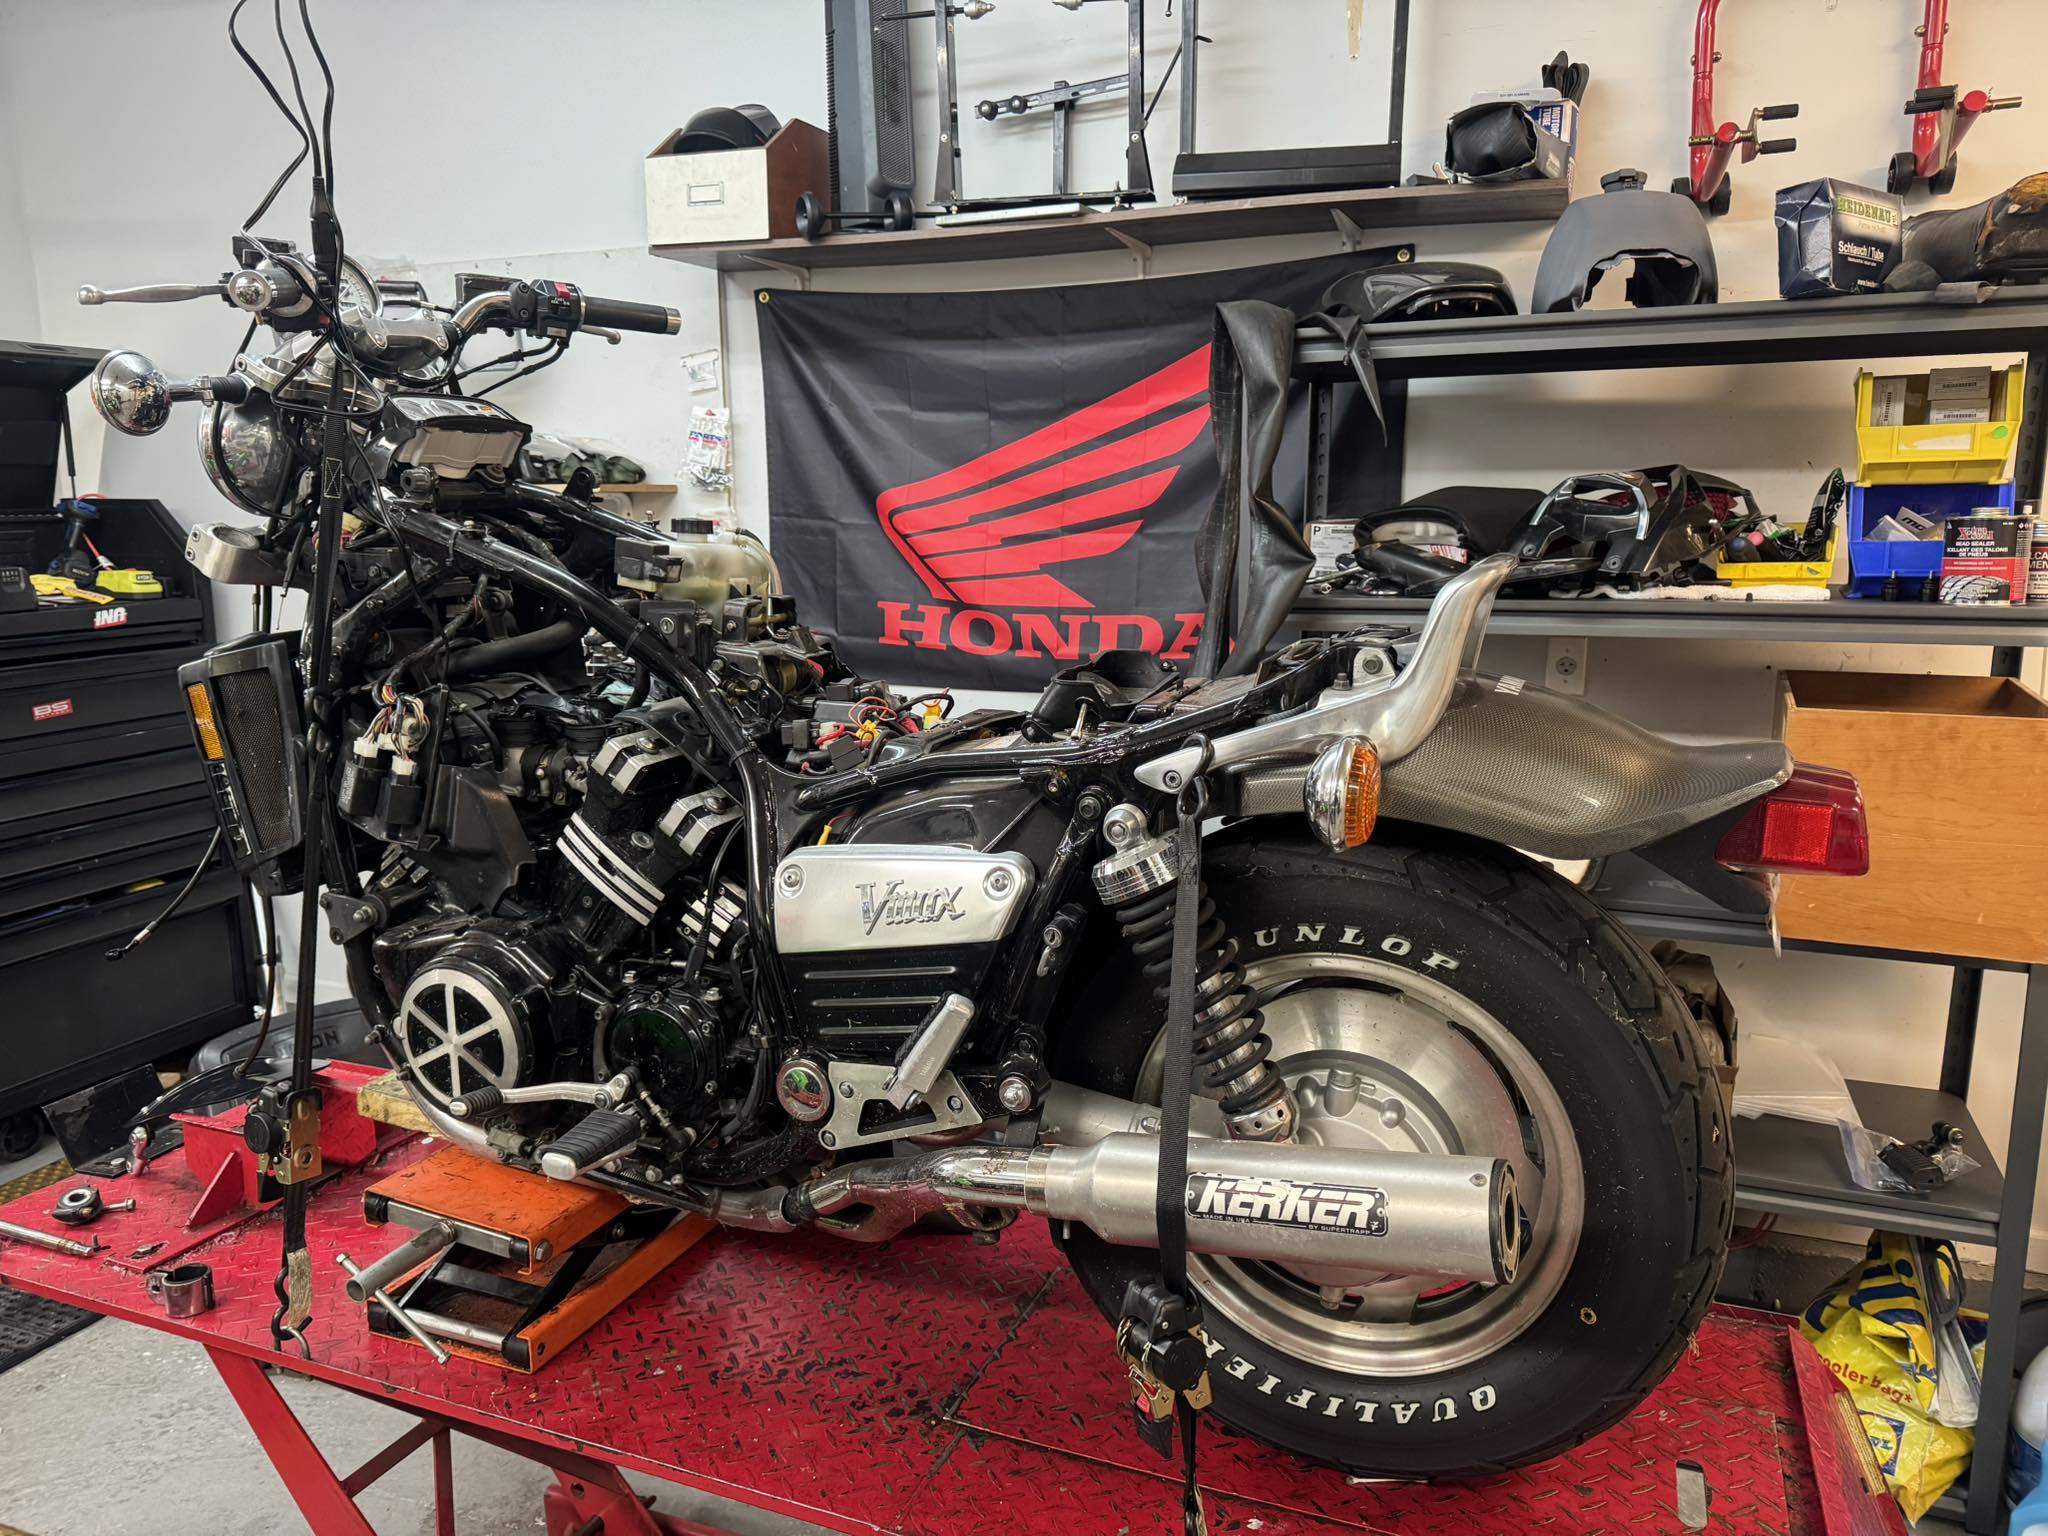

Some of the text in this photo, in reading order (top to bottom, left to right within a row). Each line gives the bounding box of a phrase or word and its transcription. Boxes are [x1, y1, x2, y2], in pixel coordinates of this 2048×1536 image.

[1838, 198, 1892, 224] HEIDENAU
[1838, 240, 1868, 257] Schlauch
[1872, 247, 1885, 261] Tube
[1313, 525, 1321, 536] P
[33, 700, 70, 716] BS
[1217, 922, 1461, 970] UNLOP
[1195, 1179, 1376, 1228] KERKER
[1320, 1226, 1371, 1235] SUPERTRAPP
[1817, 1353, 1868, 1385] ooler
